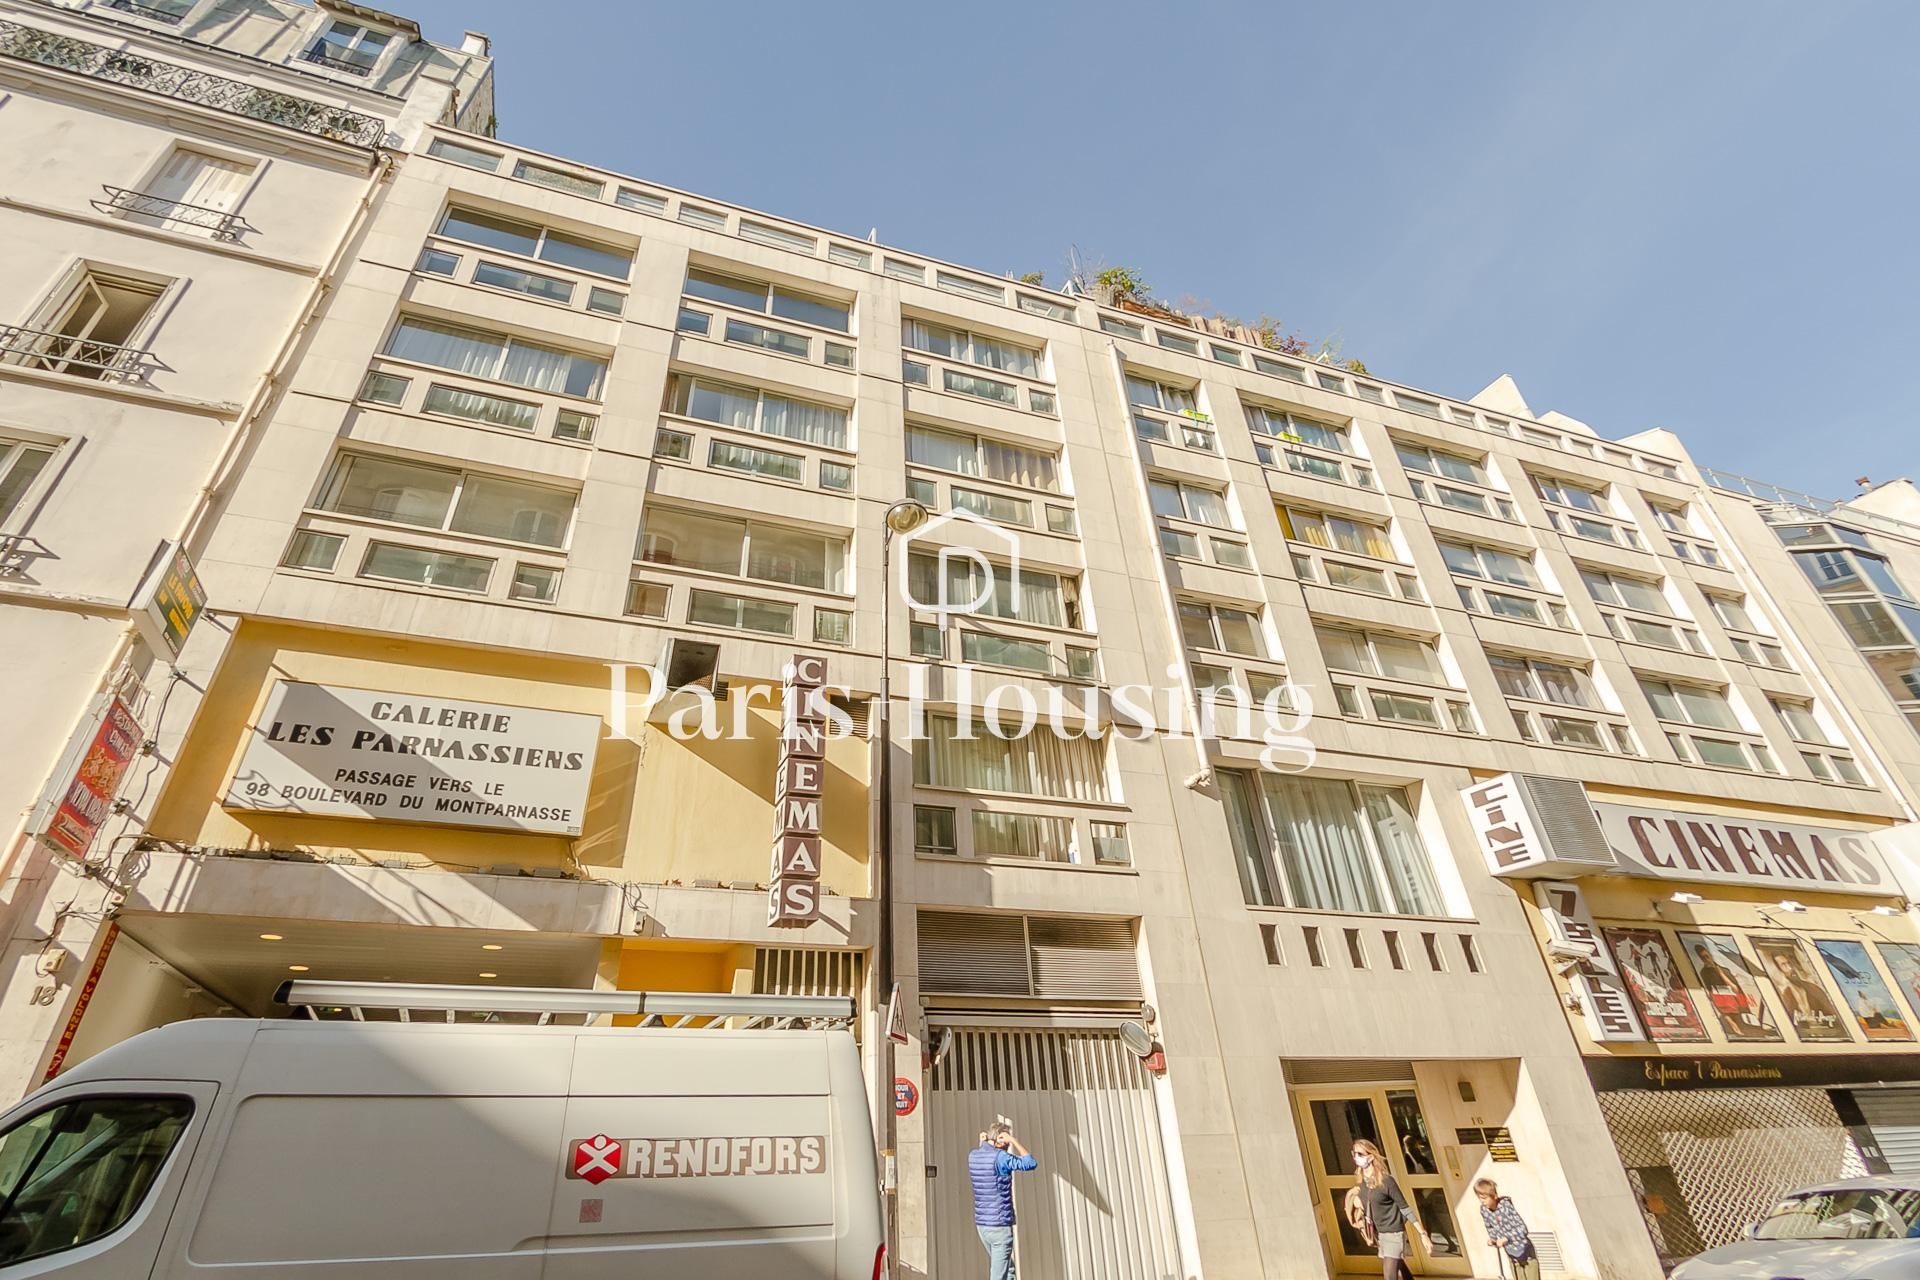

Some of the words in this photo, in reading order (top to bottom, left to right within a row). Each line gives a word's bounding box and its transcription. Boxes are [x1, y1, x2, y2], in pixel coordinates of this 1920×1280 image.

[370, 701, 512, 733] GALERIE
[266, 721, 335, 747] LES
[351, 730, 584, 771] PARNASSIENS
[244, 781, 270, 798] 98
[281, 785, 388, 808] BOULEVARD
[400, 795, 425, 810] DU
[435, 798, 573, 823] MONTPARNASSE
[334, 768, 417, 789] PASSAGE
[429, 777, 473, 794] VERS
[484, 782, 505, 797] LE
[784, 658, 822, 915] CINEMAS
[1627, 815, 1882, 885] CINEMAS
[29, 985, 57, 1007] 18
[1644, 1060, 1689, 1086] Espace
[626, 1137, 821, 1177] RENOFORS
